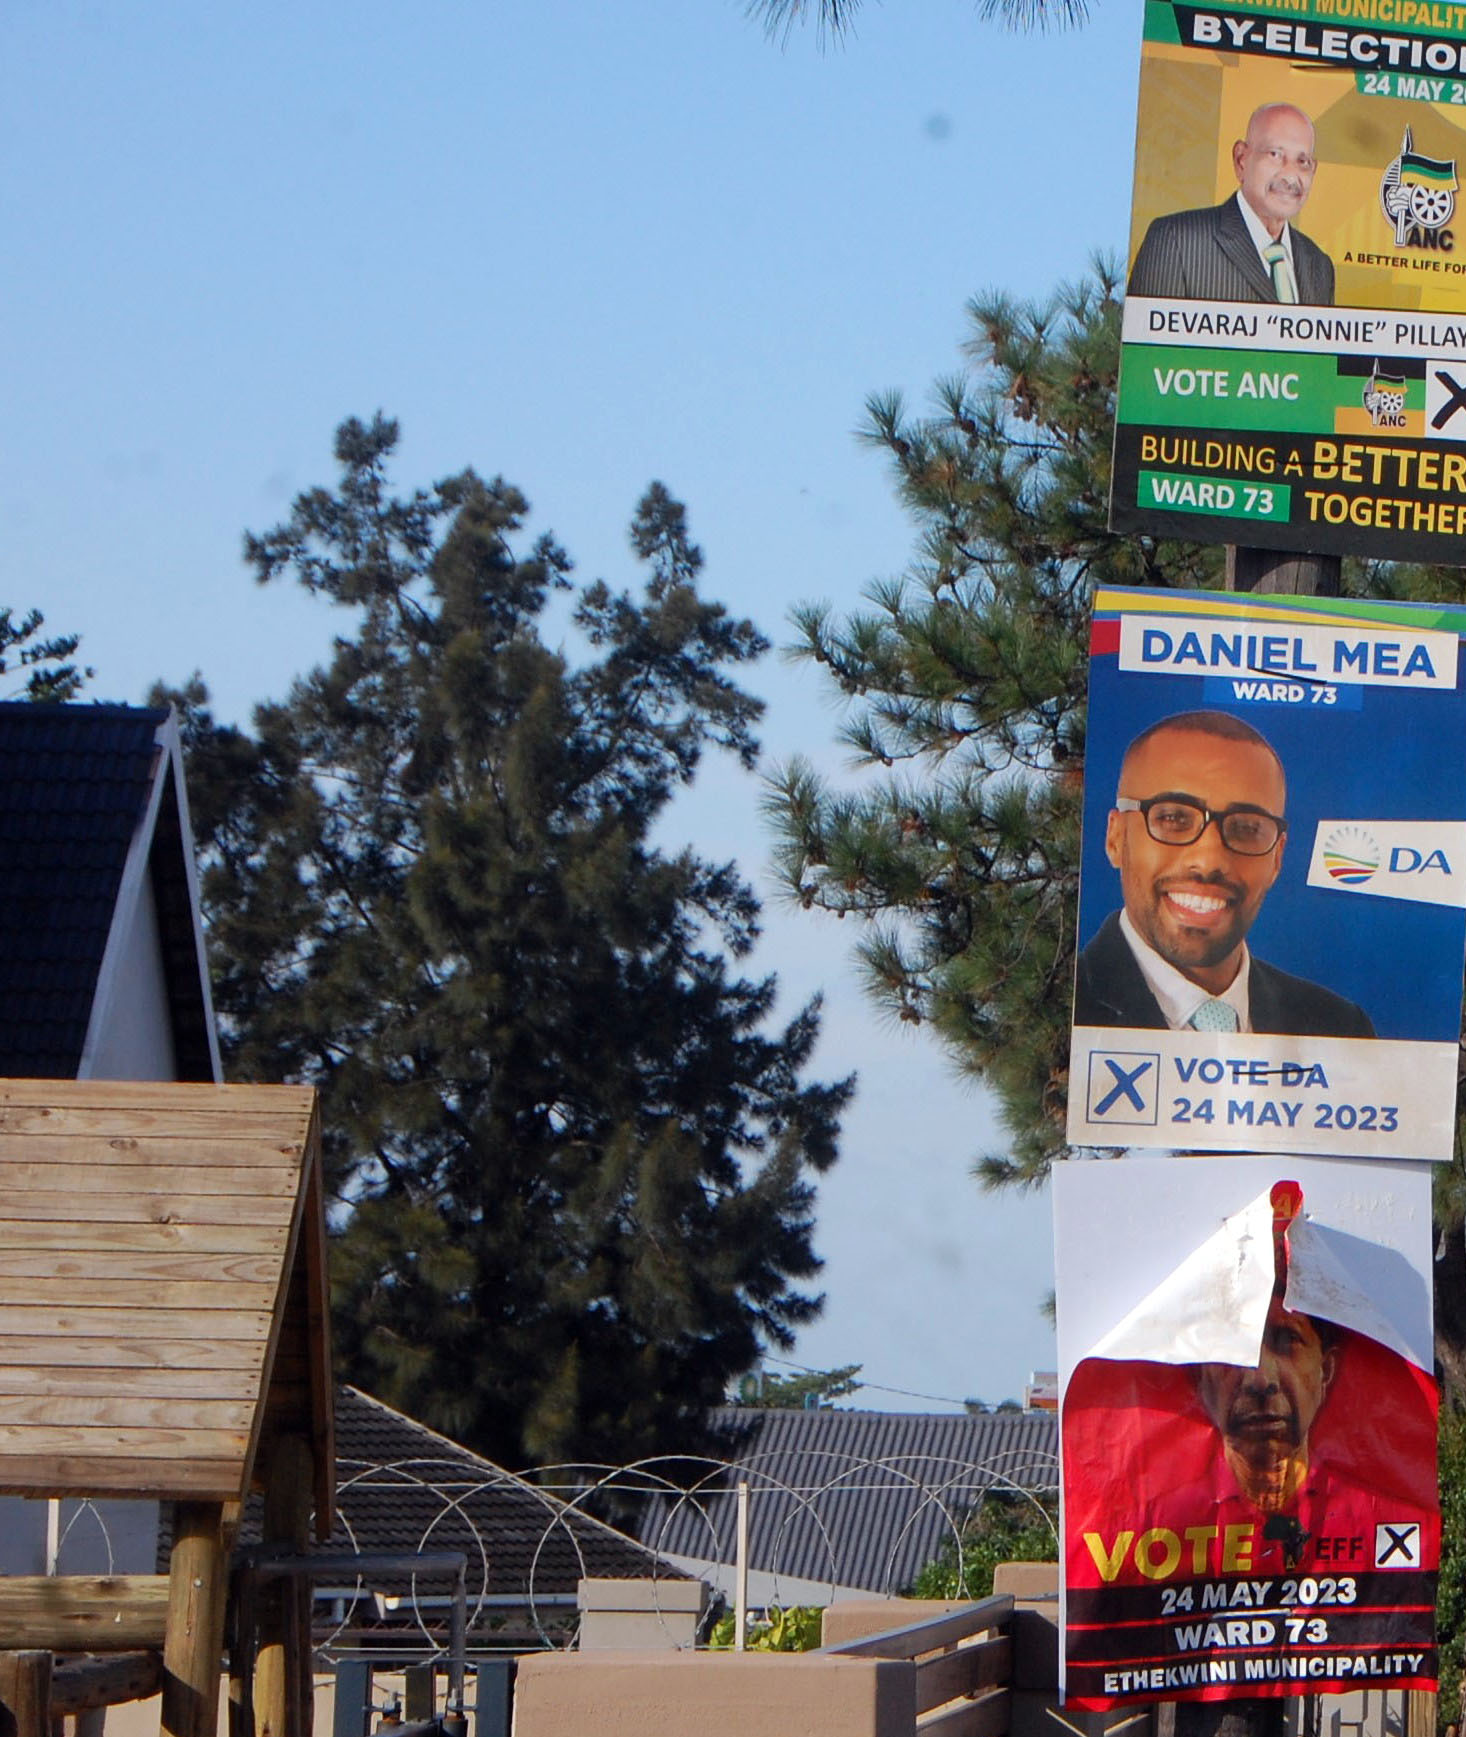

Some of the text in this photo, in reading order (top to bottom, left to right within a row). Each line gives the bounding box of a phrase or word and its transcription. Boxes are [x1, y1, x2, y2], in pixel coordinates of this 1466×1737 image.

[1363, 73, 1391, 96] 24
[1397, 78, 1445, 102] MAY
[1406, 228, 1454, 251] ANC
[1344, 251, 1353, 263] A
[1357, 253, 1408, 269] BETTER
[1412, 260, 1440, 272] LIFE
[1149, 310, 1258, 337] DEVARAJ
[1153, 367, 1300, 400] VOTE ANC
[1379, 415, 1406, 428] ANC
[1141, 435, 1275, 474] BUILDING
[1283, 450, 1303, 477] A
[1151, 477, 1274, 514] WARD 73
[1141, 629, 1437, 679] DANIEL MEA
[1232, 681, 1337, 705] WARD 73
[1389, 847, 1452, 876] DA
[1174, 1057, 1329, 1089] VOTE DA
[1171, 1098, 1399, 1132] 24 MAY 2023
[1083, 1523, 1363, 1583] VOTE EFF
[1161, 1577, 1357, 1616] 24 MAY 2023
[1174, 1618, 1329, 1651] WARD 73
[1104, 1653, 1424, 1694] ETHEKWINI MUNICIPALITY
